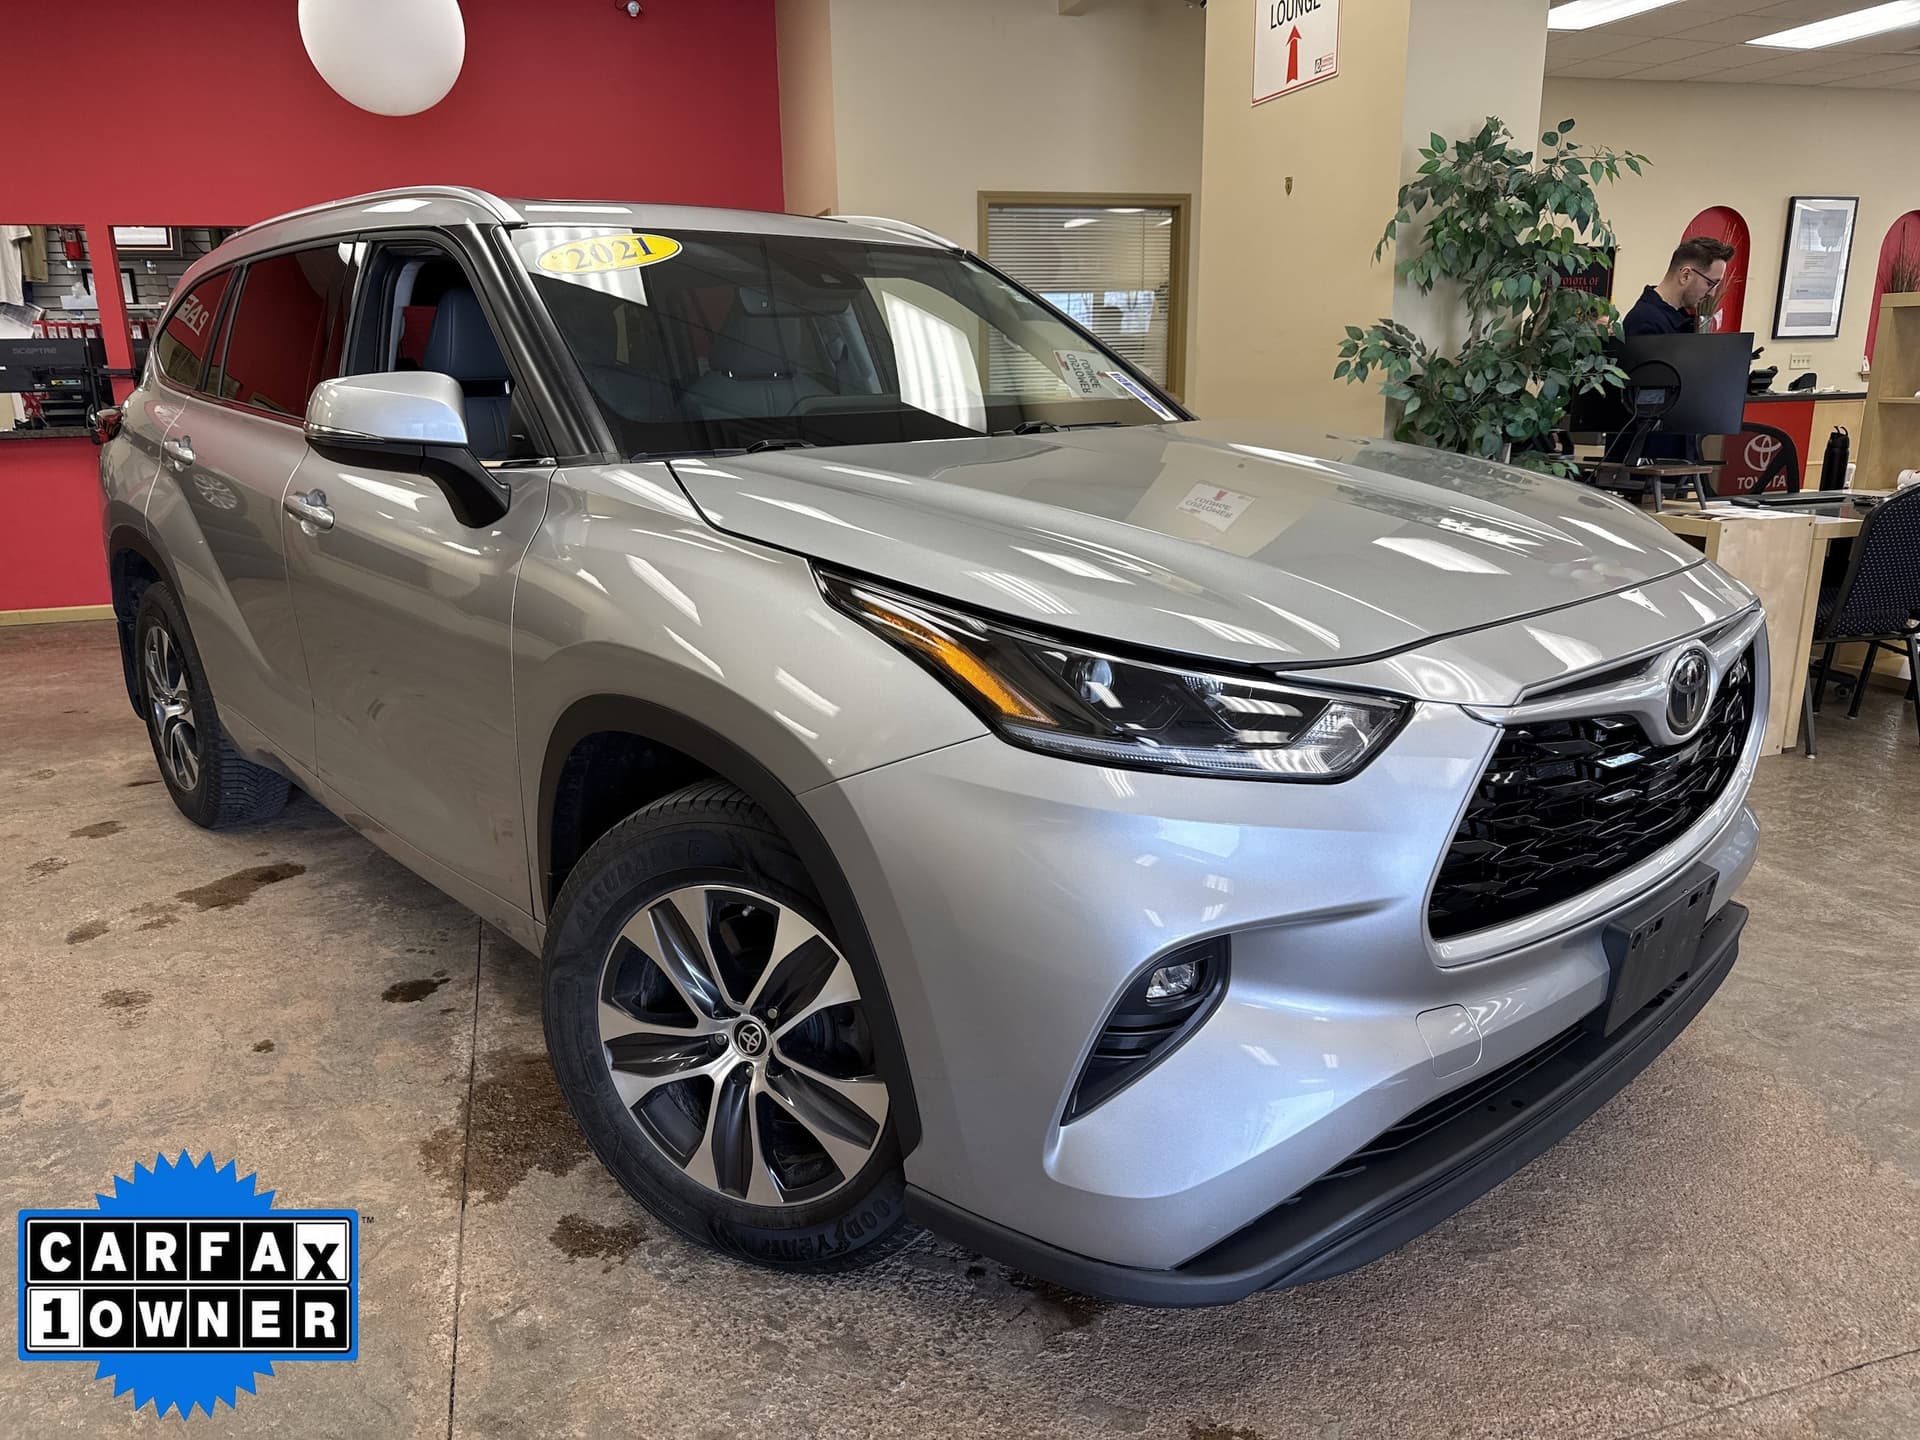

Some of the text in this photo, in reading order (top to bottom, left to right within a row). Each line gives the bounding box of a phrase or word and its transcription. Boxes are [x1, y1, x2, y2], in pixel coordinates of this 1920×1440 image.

[566, 236, 656, 269] 2021
[12, 346, 57, 354] SCEPTRE
[1737, 475, 1787, 490] TOTA
[760, 1197, 898, 1258] OODYEAR
